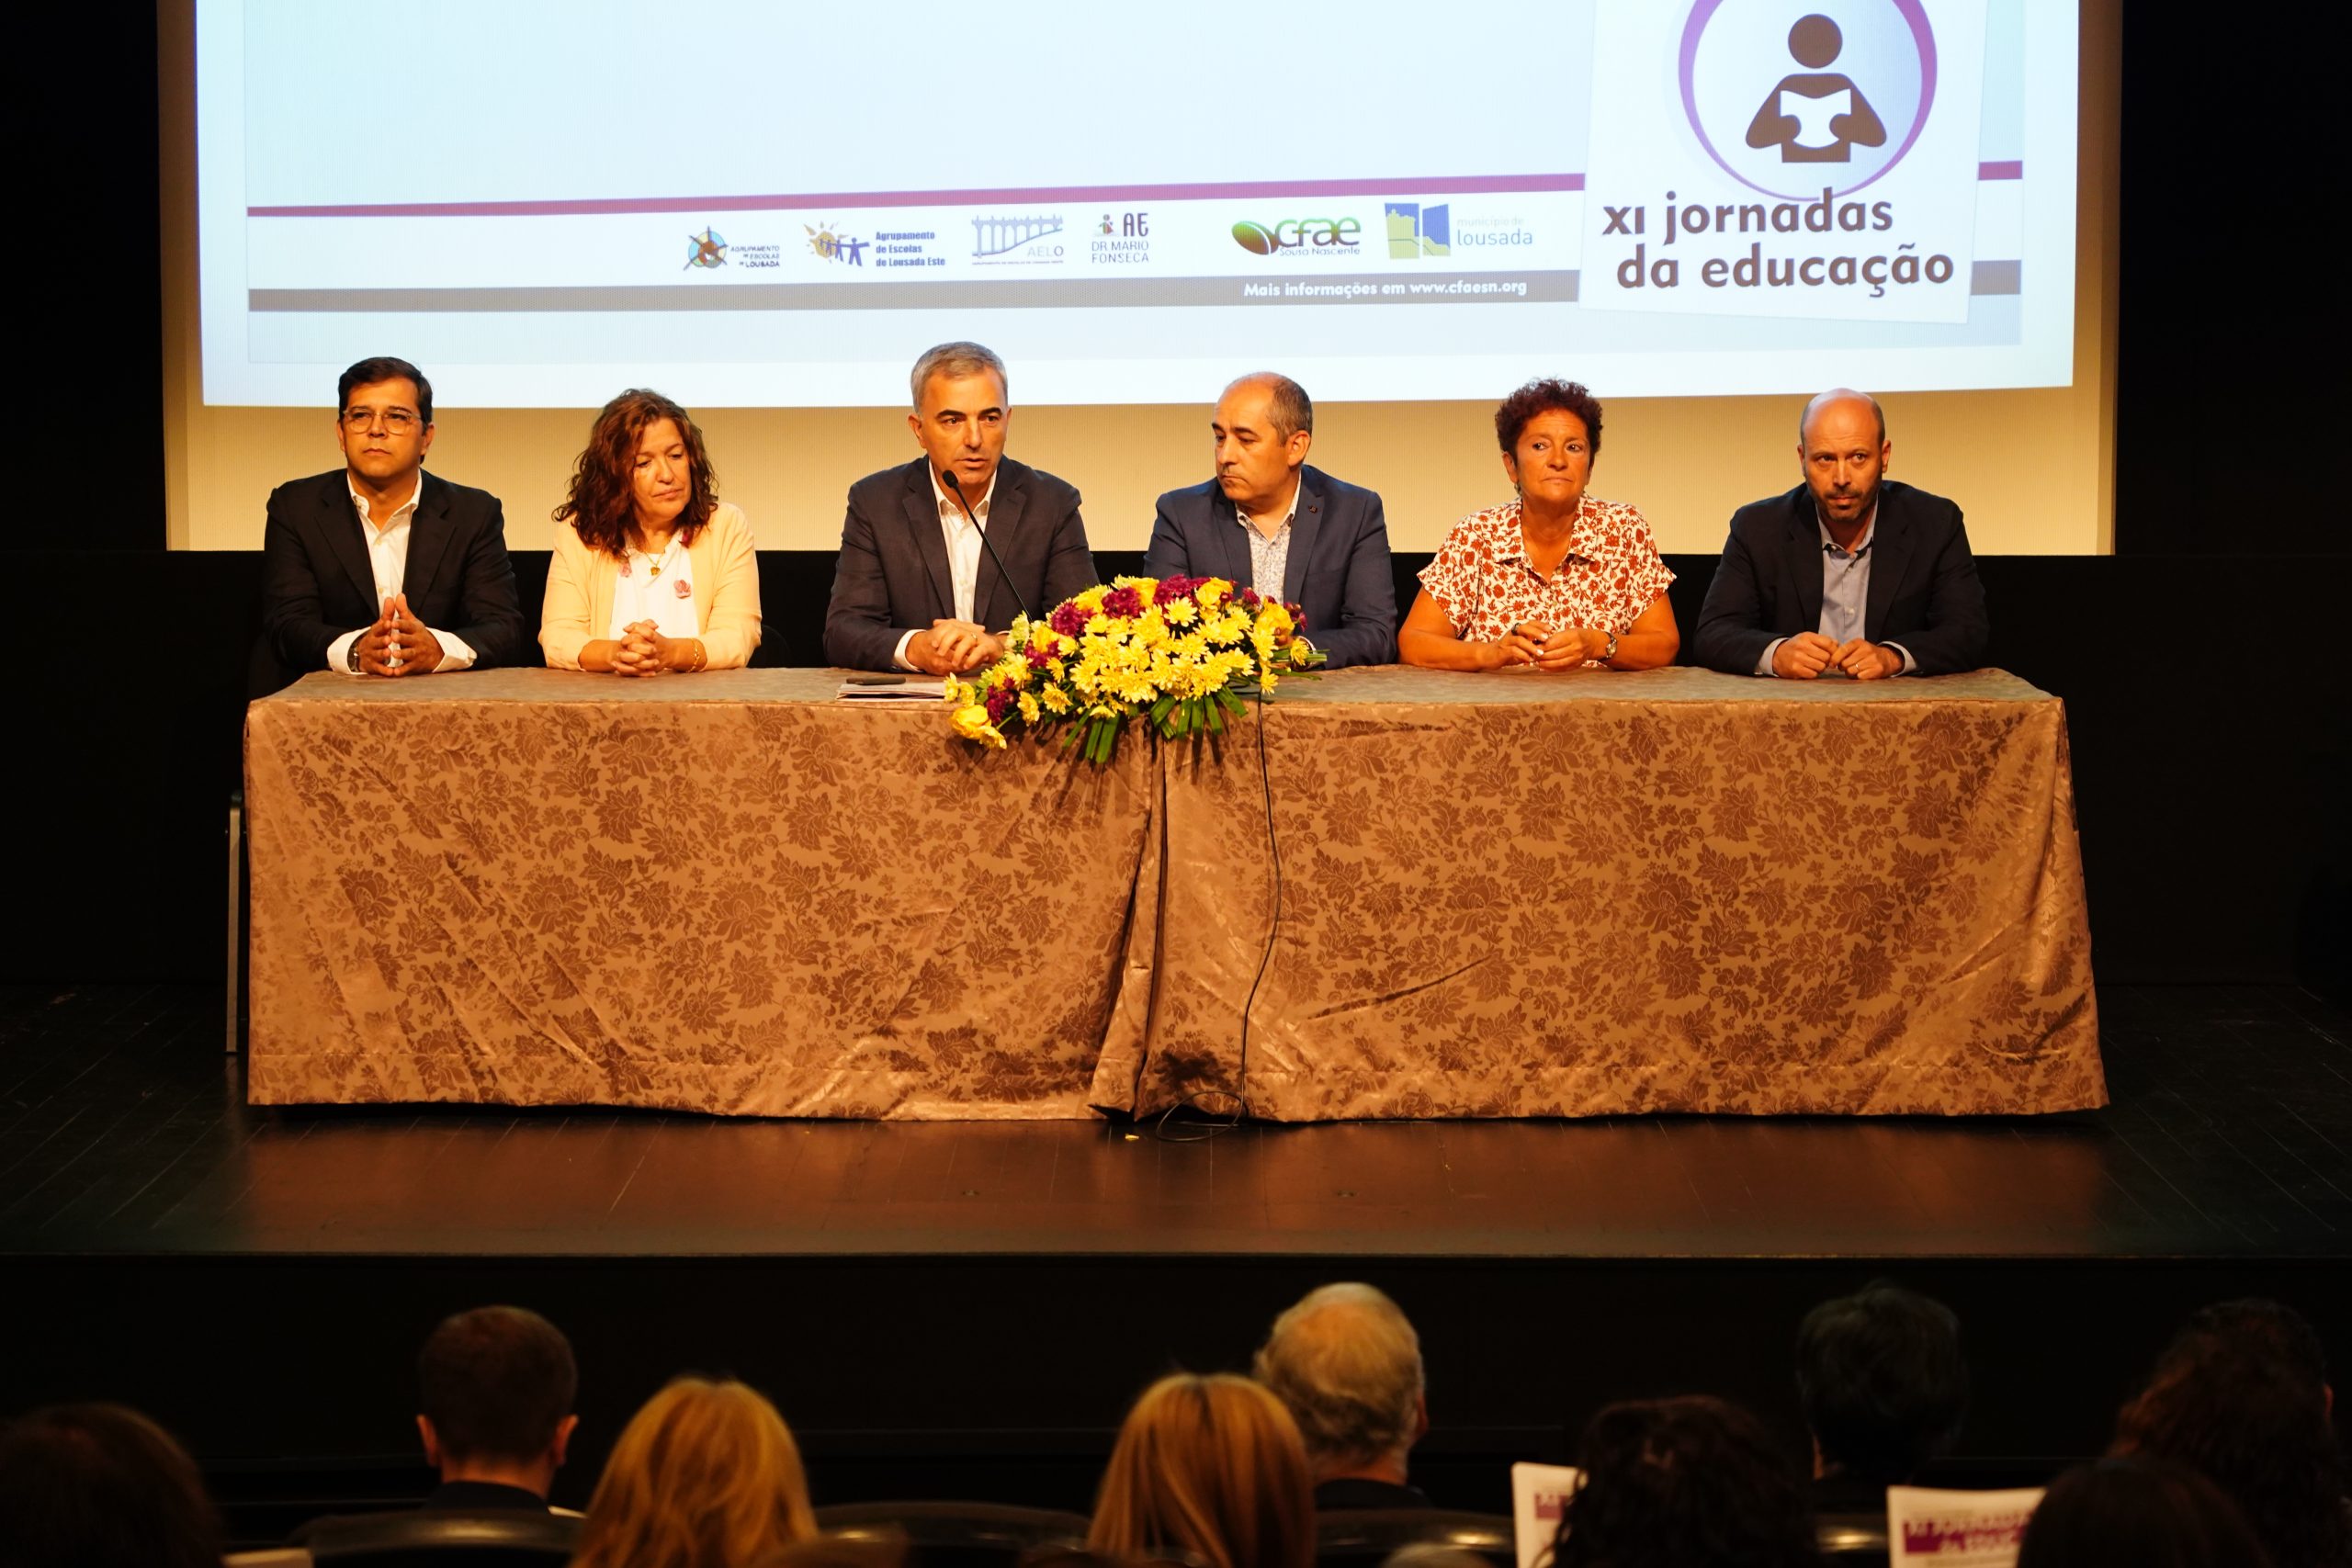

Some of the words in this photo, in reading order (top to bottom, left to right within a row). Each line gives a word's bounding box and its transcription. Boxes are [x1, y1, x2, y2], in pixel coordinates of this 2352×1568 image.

[1663, 186, 1894, 245] jornadas
[1123, 212, 1149, 237] AE
[1275, 217, 1362, 247] cfae
[876, 231, 935, 241] Agrupamento
[1457, 228, 1533, 246] lousada
[876, 245, 887, 254] de
[888, 244, 922, 254] Escolas
[1027, 245, 1064, 257] AELO
[1279, 246, 1308, 256] Sousa
[1311, 246, 1361, 255] Nascente
[876, 258, 887, 266] de
[888, 257, 925, 266] Lousada
[927, 256, 945, 265] Este
[1091, 253, 1149, 264] FONSECA
[1617, 243, 1679, 288] da
[1702, 242, 1954, 298] educação
[1243, 283, 1281, 297] Mais
[1284, 281, 1378, 299] informações
[1382, 283, 1406, 295] em
[1409, 280, 1528, 295] www.cfaesn.org
